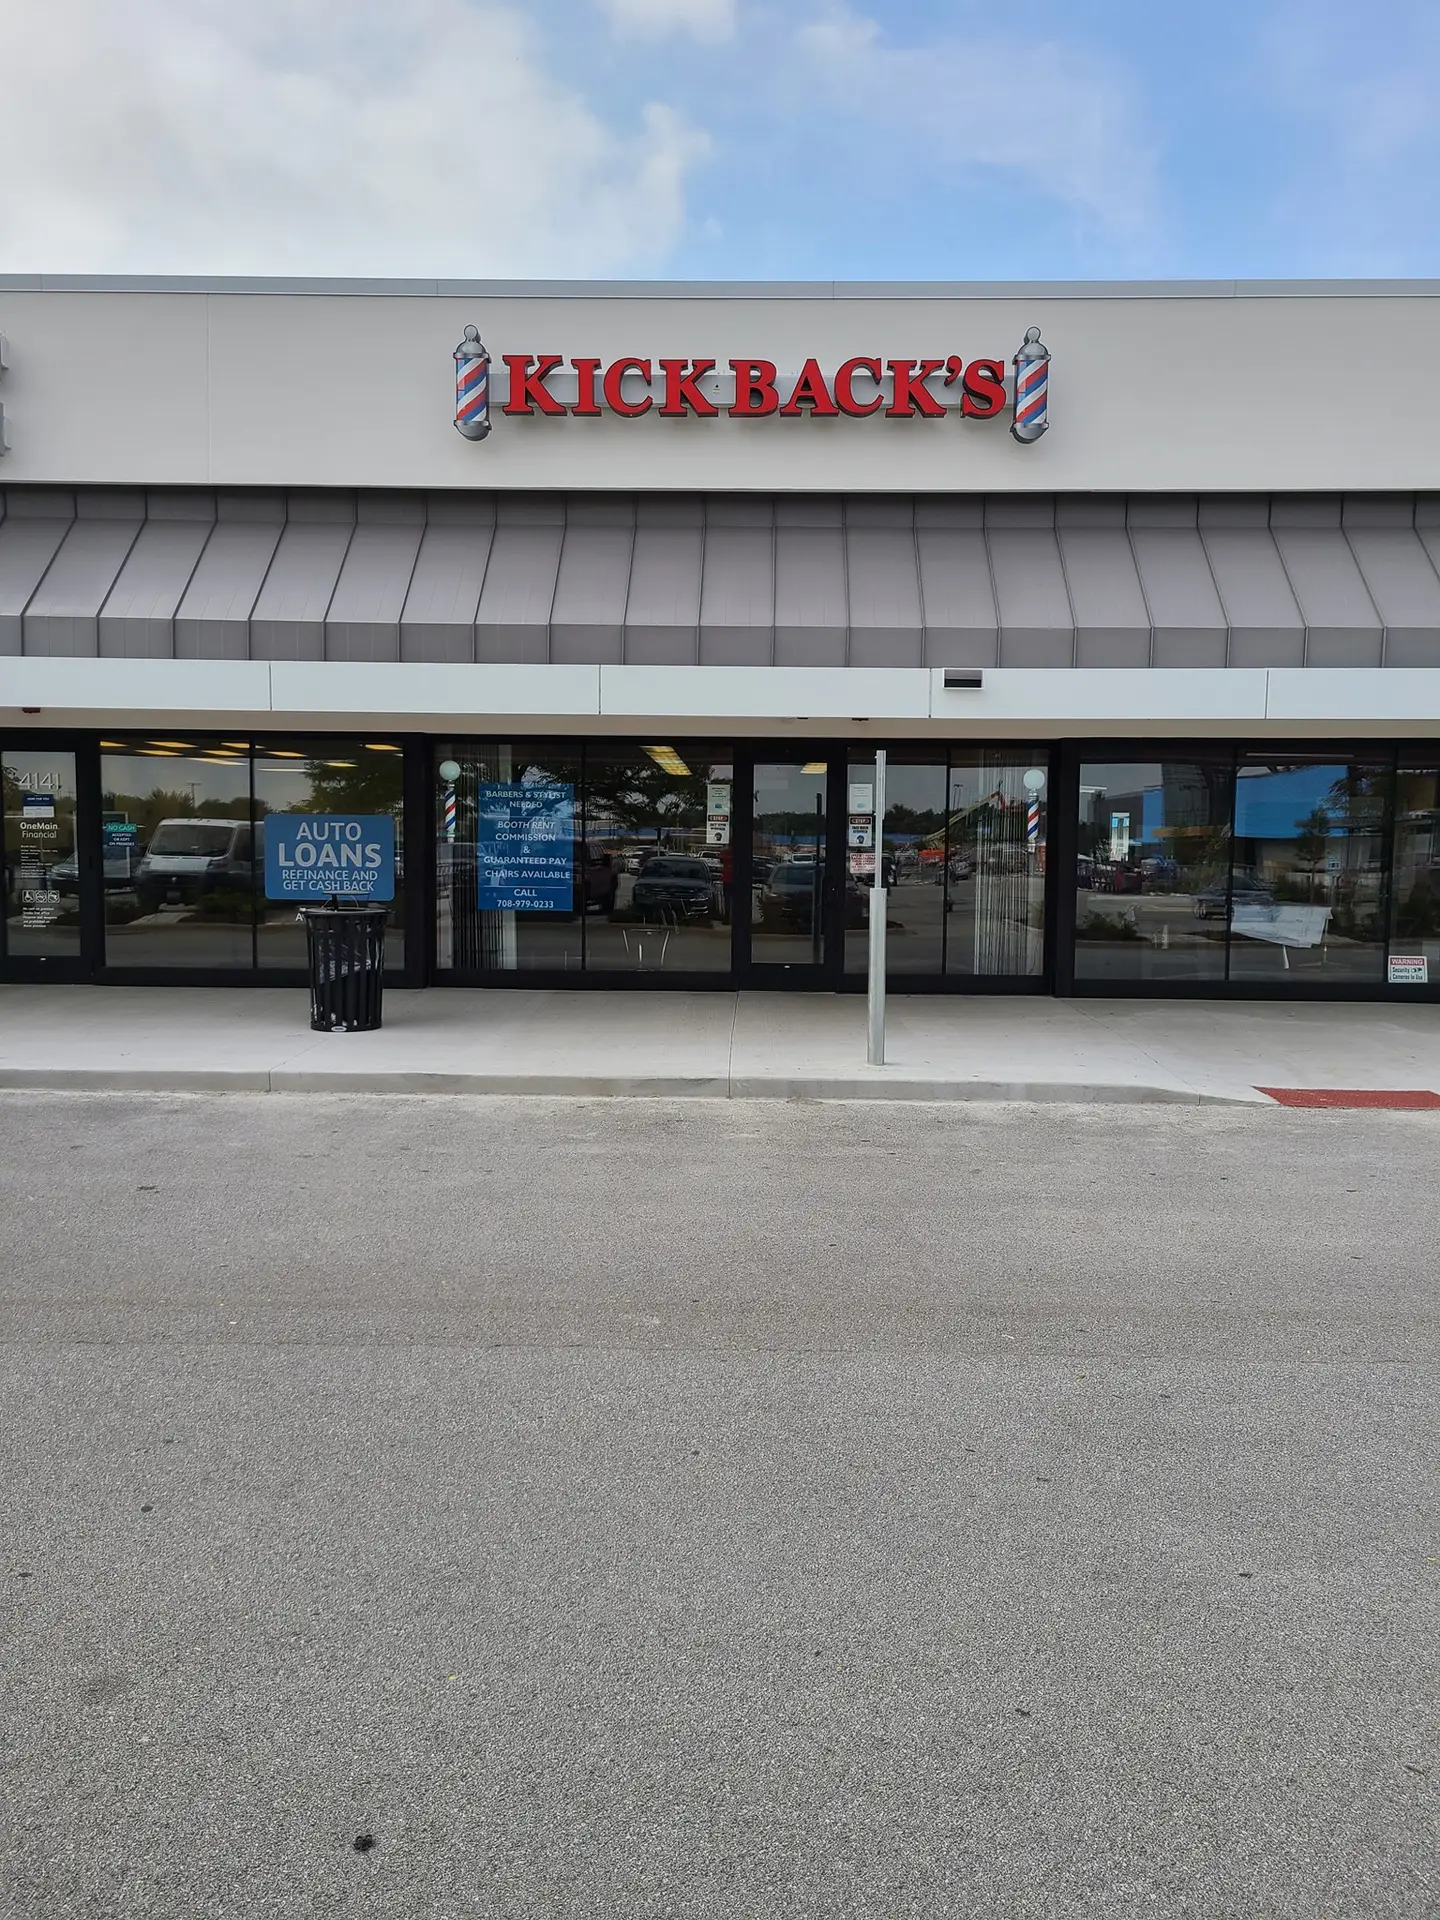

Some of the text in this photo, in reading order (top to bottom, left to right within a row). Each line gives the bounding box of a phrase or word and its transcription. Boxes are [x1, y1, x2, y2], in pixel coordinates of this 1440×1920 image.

[20, 772, 60, 790] 4141
[486, 790, 523, 798] BARBERS
[533, 791, 566, 799] STYLIST
[497, 820, 556, 829] BOOTH RENT
[22, 830, 57, 838] Financial
[295, 822, 362, 841] AUTO
[495, 833, 556, 841] COMMISSION
[523, 845, 531, 854] &
[278, 842, 382, 868] LOANS
[483, 856, 567, 865] GUARANTEED PAY
[282, 869, 378, 880] REFINANCE AND
[485, 869, 571, 879] CHAIRS AVAILABLE
[283, 880, 375, 892] GET CASH BACK
[513, 888, 538, 897] CALL
[496, 899, 554, 908] 708-979-0233
